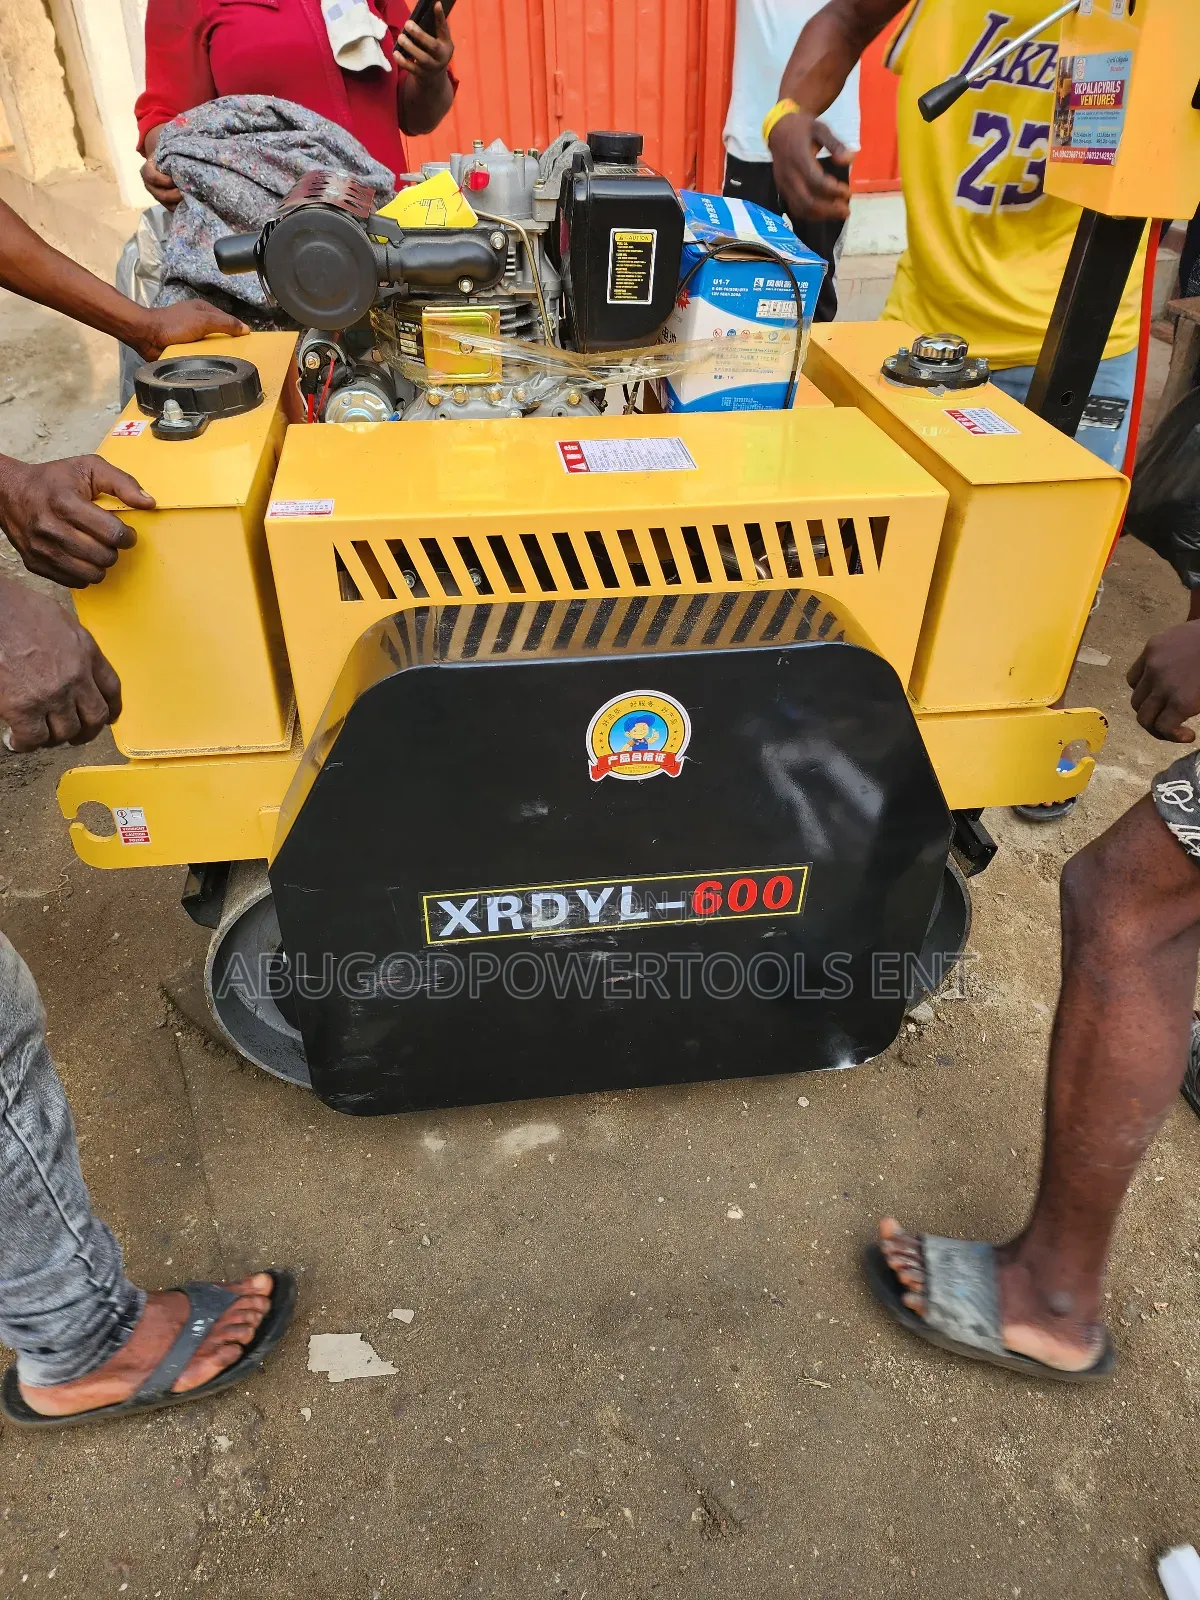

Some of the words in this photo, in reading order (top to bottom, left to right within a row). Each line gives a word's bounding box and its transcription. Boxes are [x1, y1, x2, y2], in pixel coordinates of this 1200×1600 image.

[1075, 80, 1121, 95] OKPALACYRILS
[1080, 94, 1116, 106] VENTURES
[954, 109, 1050, 214] 23
[766, 279, 808, 289] 风帆蓄池
[607, 752, 666, 765] 产品合格证
[437, 875, 794, 936] XRDYL-600
